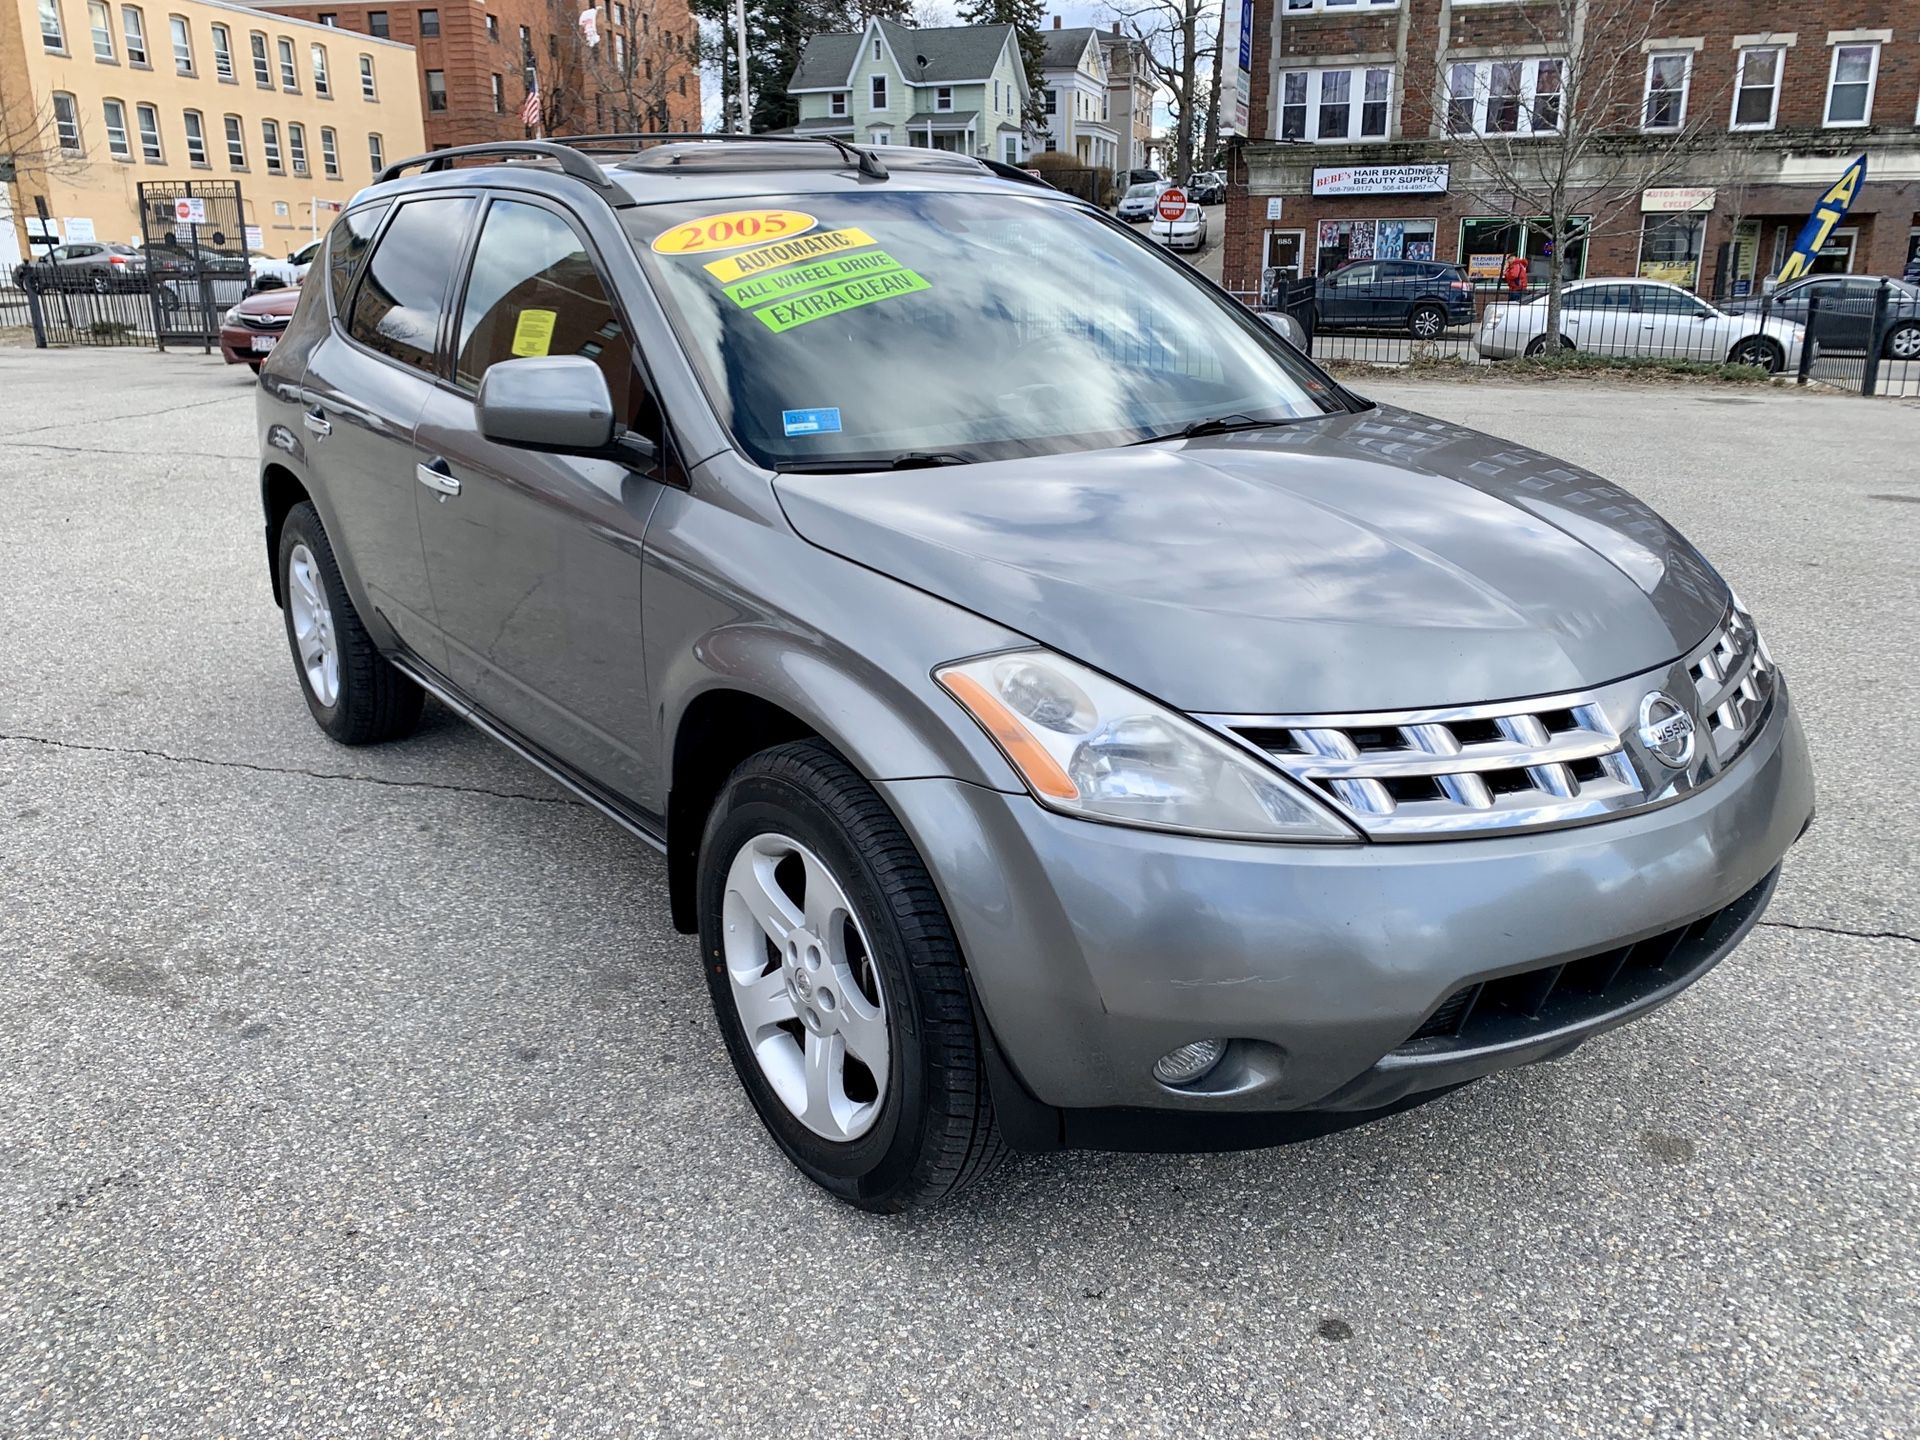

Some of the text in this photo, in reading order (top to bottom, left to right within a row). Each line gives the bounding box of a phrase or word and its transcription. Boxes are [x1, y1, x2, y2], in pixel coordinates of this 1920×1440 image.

[1316, 171, 1351, 187] BEBE's
[1353, 175, 1440, 185] BEAUTY SUPPLY
[1354, 165, 1445, 177] HAIR BRAIDING &
[681, 213, 786, 249] 2005
[735, 232, 849, 272] AUTOMATIC
[737, 254, 891, 302] ALL WHEEL DRIVE
[770, 273, 913, 325] EXTRA CLEAN
[1651, 719, 1693, 740] NISSAN
